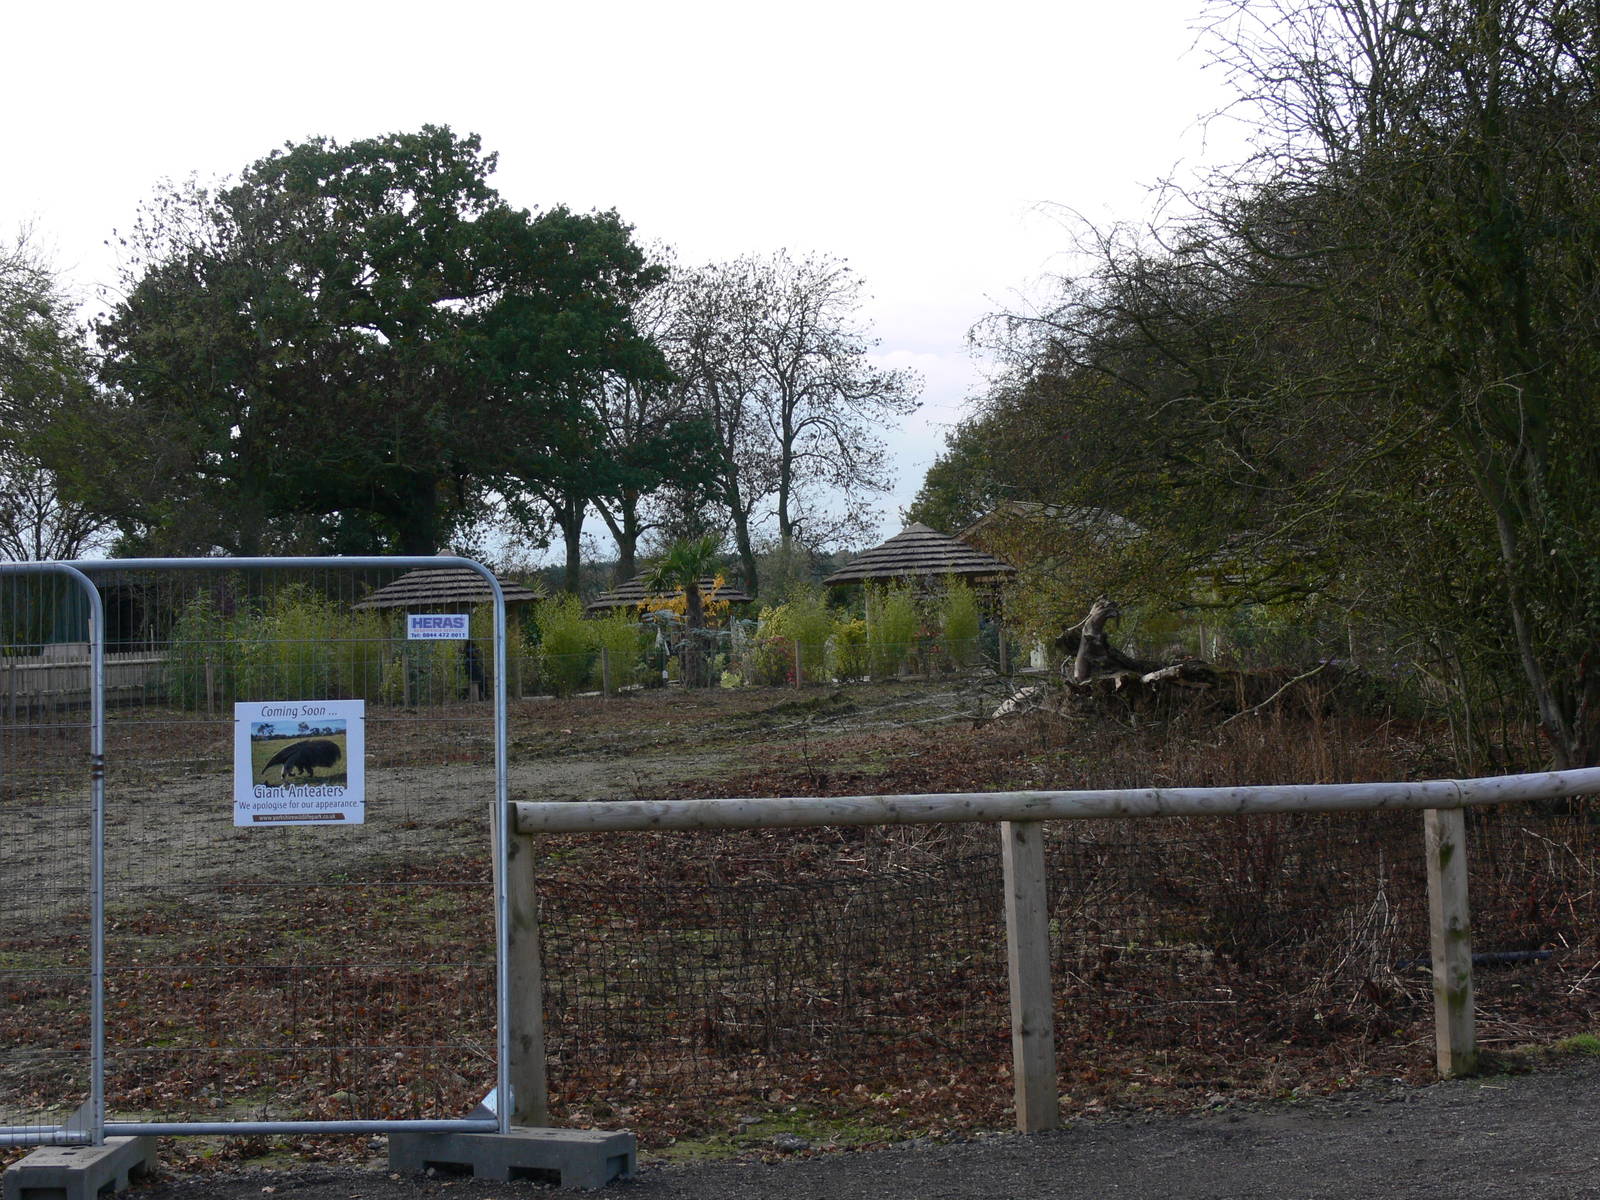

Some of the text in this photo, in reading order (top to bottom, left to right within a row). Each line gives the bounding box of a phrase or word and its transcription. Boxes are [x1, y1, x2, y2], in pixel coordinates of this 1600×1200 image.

[412, 617, 464, 629] HERAS
[261, 705, 298, 719] Coming
[301, 705, 326, 716] Soon
[254, 784, 344, 798] Giant Anteaters
[239, 801, 251, 810] We
[252, 801, 287, 811] apologise
[289, 800, 299, 808] for
[315, 801, 359, 810] appearance.
